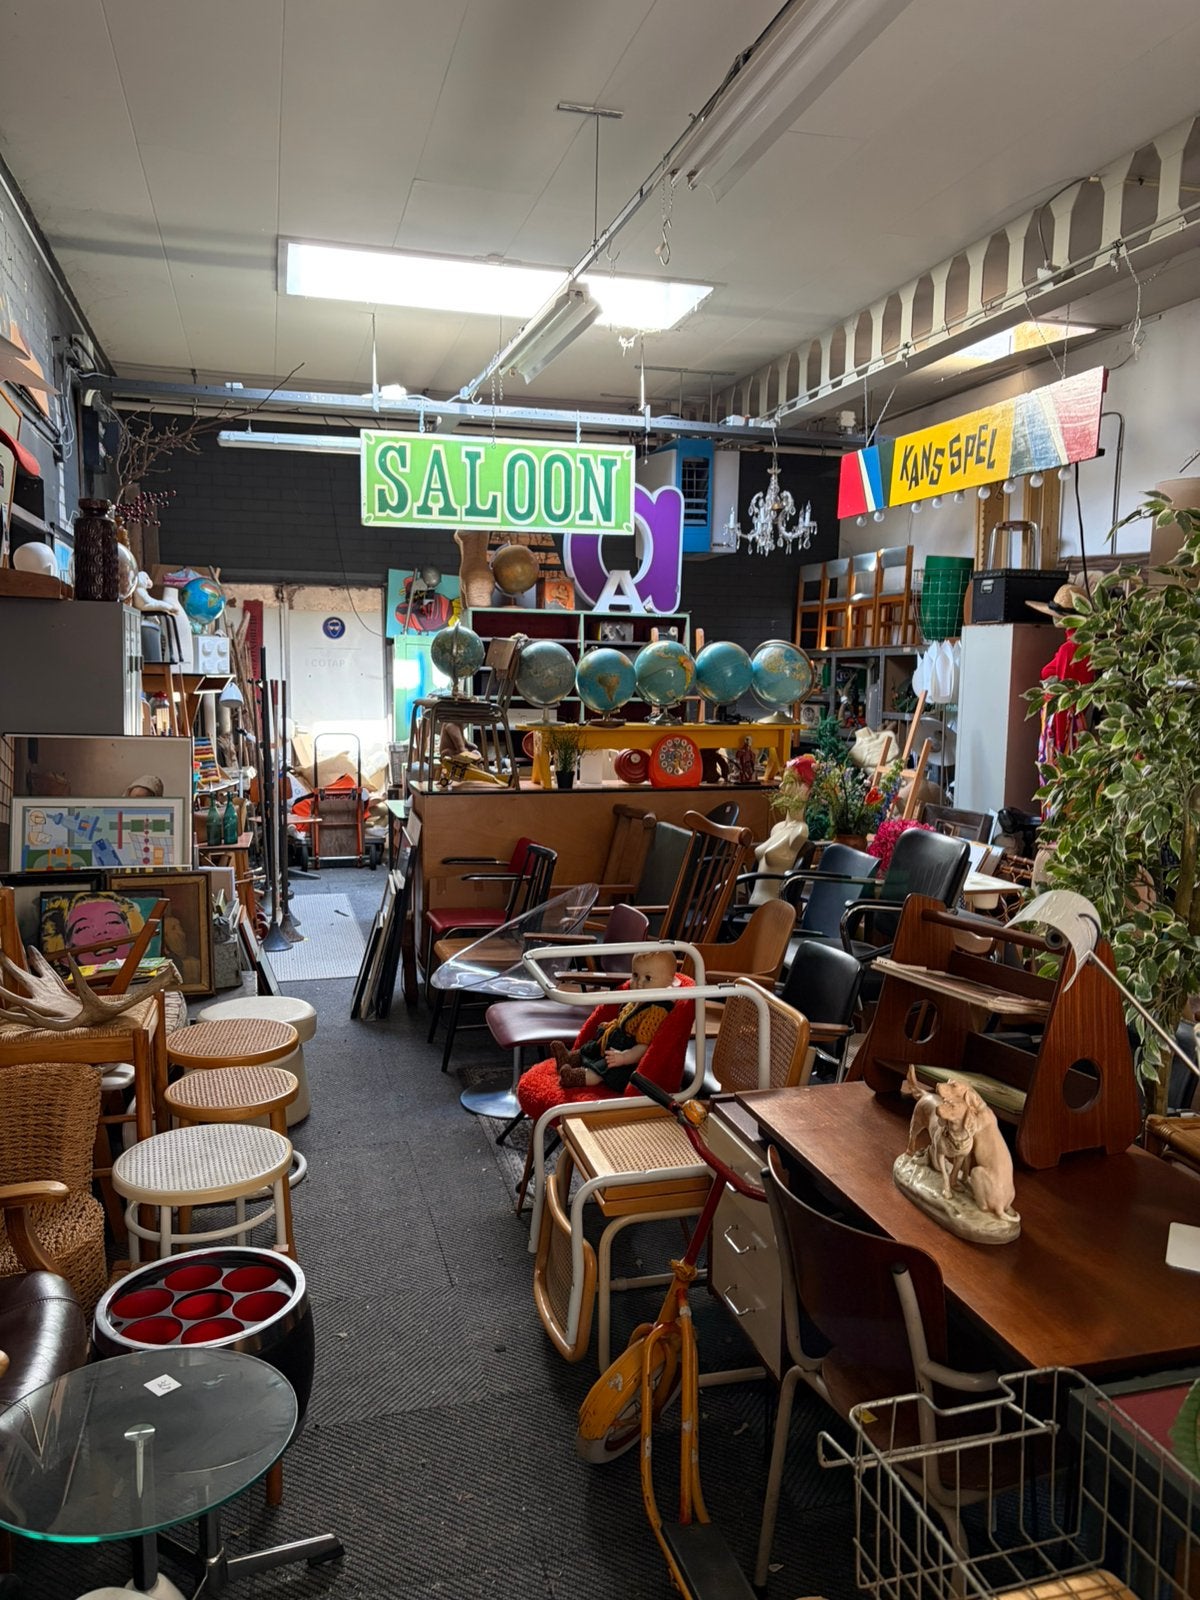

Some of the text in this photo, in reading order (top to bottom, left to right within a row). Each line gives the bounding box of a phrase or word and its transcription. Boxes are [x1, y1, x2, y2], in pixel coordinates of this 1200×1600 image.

[375, 441, 621, 526] SALOON
[899, 424, 998, 491] KANS SPEL
[592, 569, 648, 613] A
